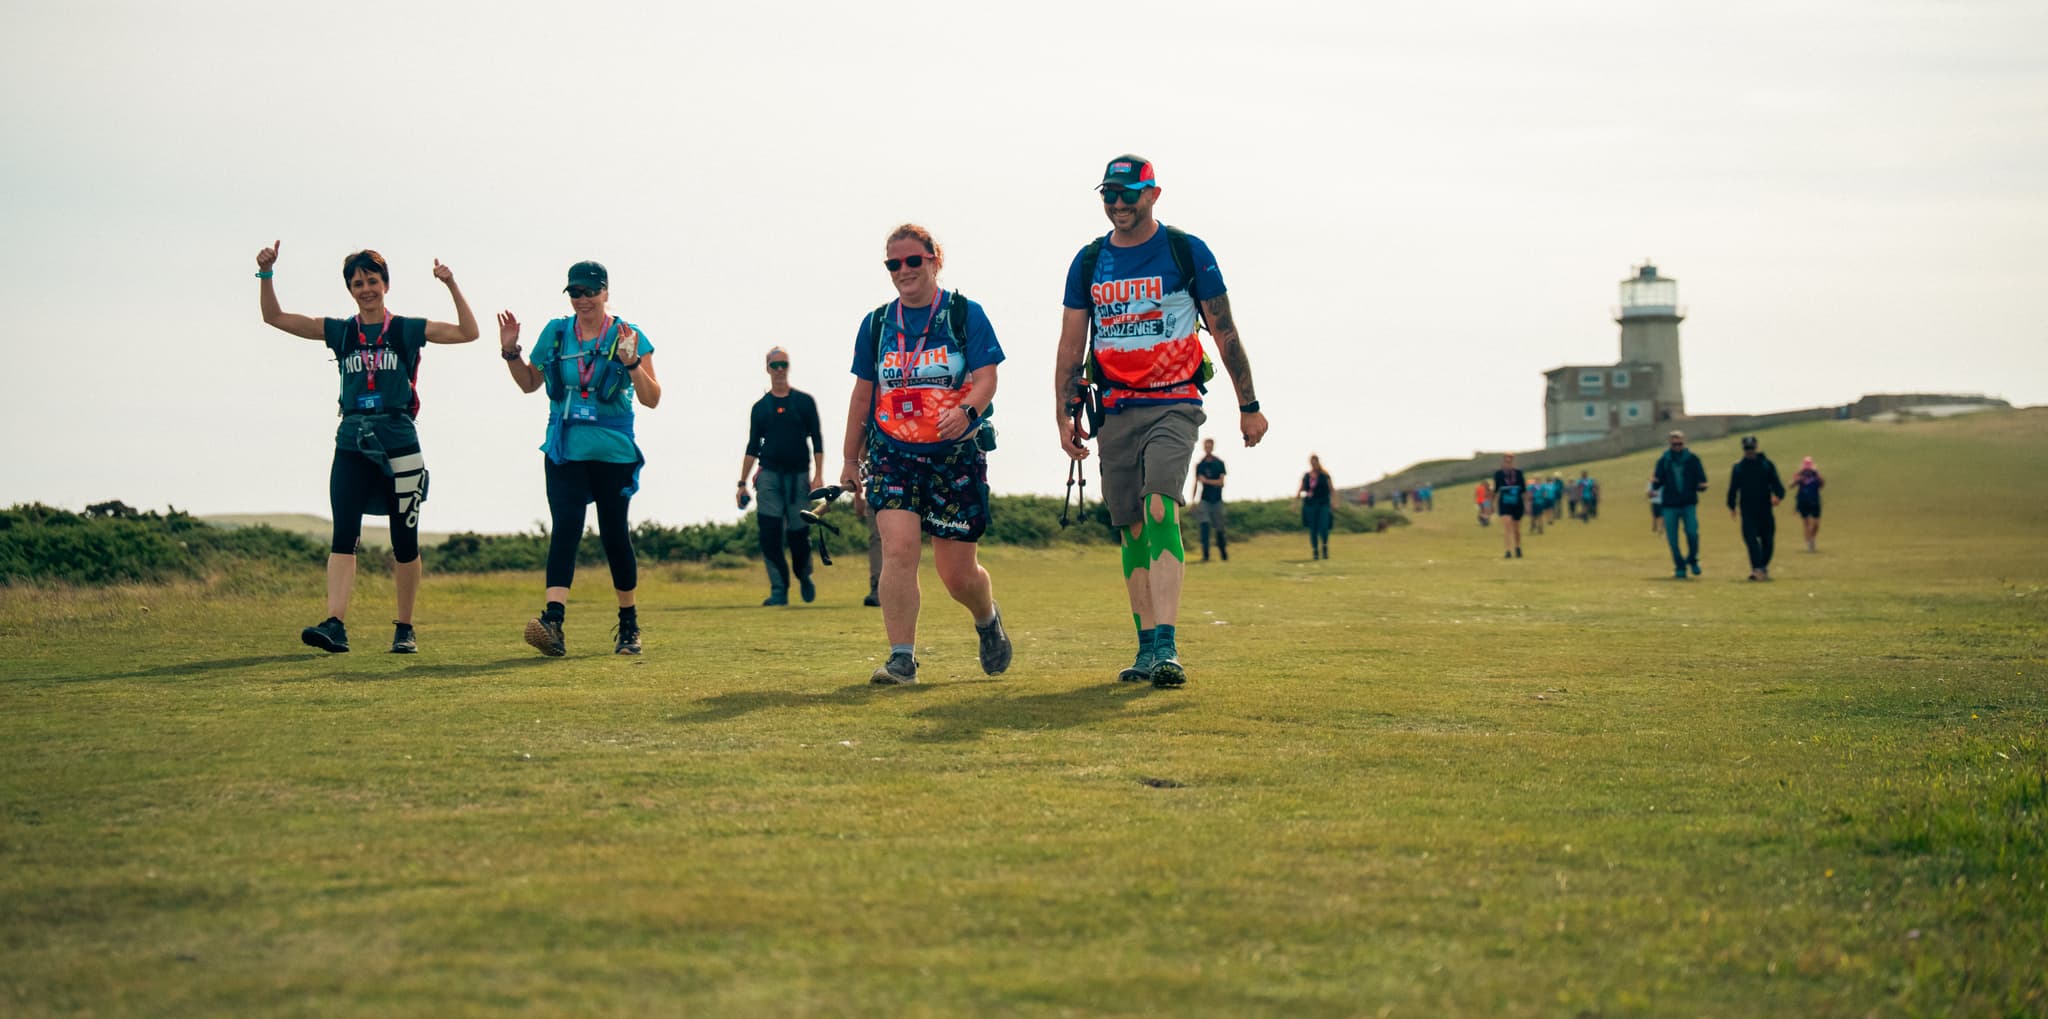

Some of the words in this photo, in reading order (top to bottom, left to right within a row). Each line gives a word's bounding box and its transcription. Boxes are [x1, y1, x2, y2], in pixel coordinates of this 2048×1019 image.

[1091, 276, 1162, 305] SOUTH
[345, 355, 362, 373] NO
[882, 367, 920, 379] COAT
